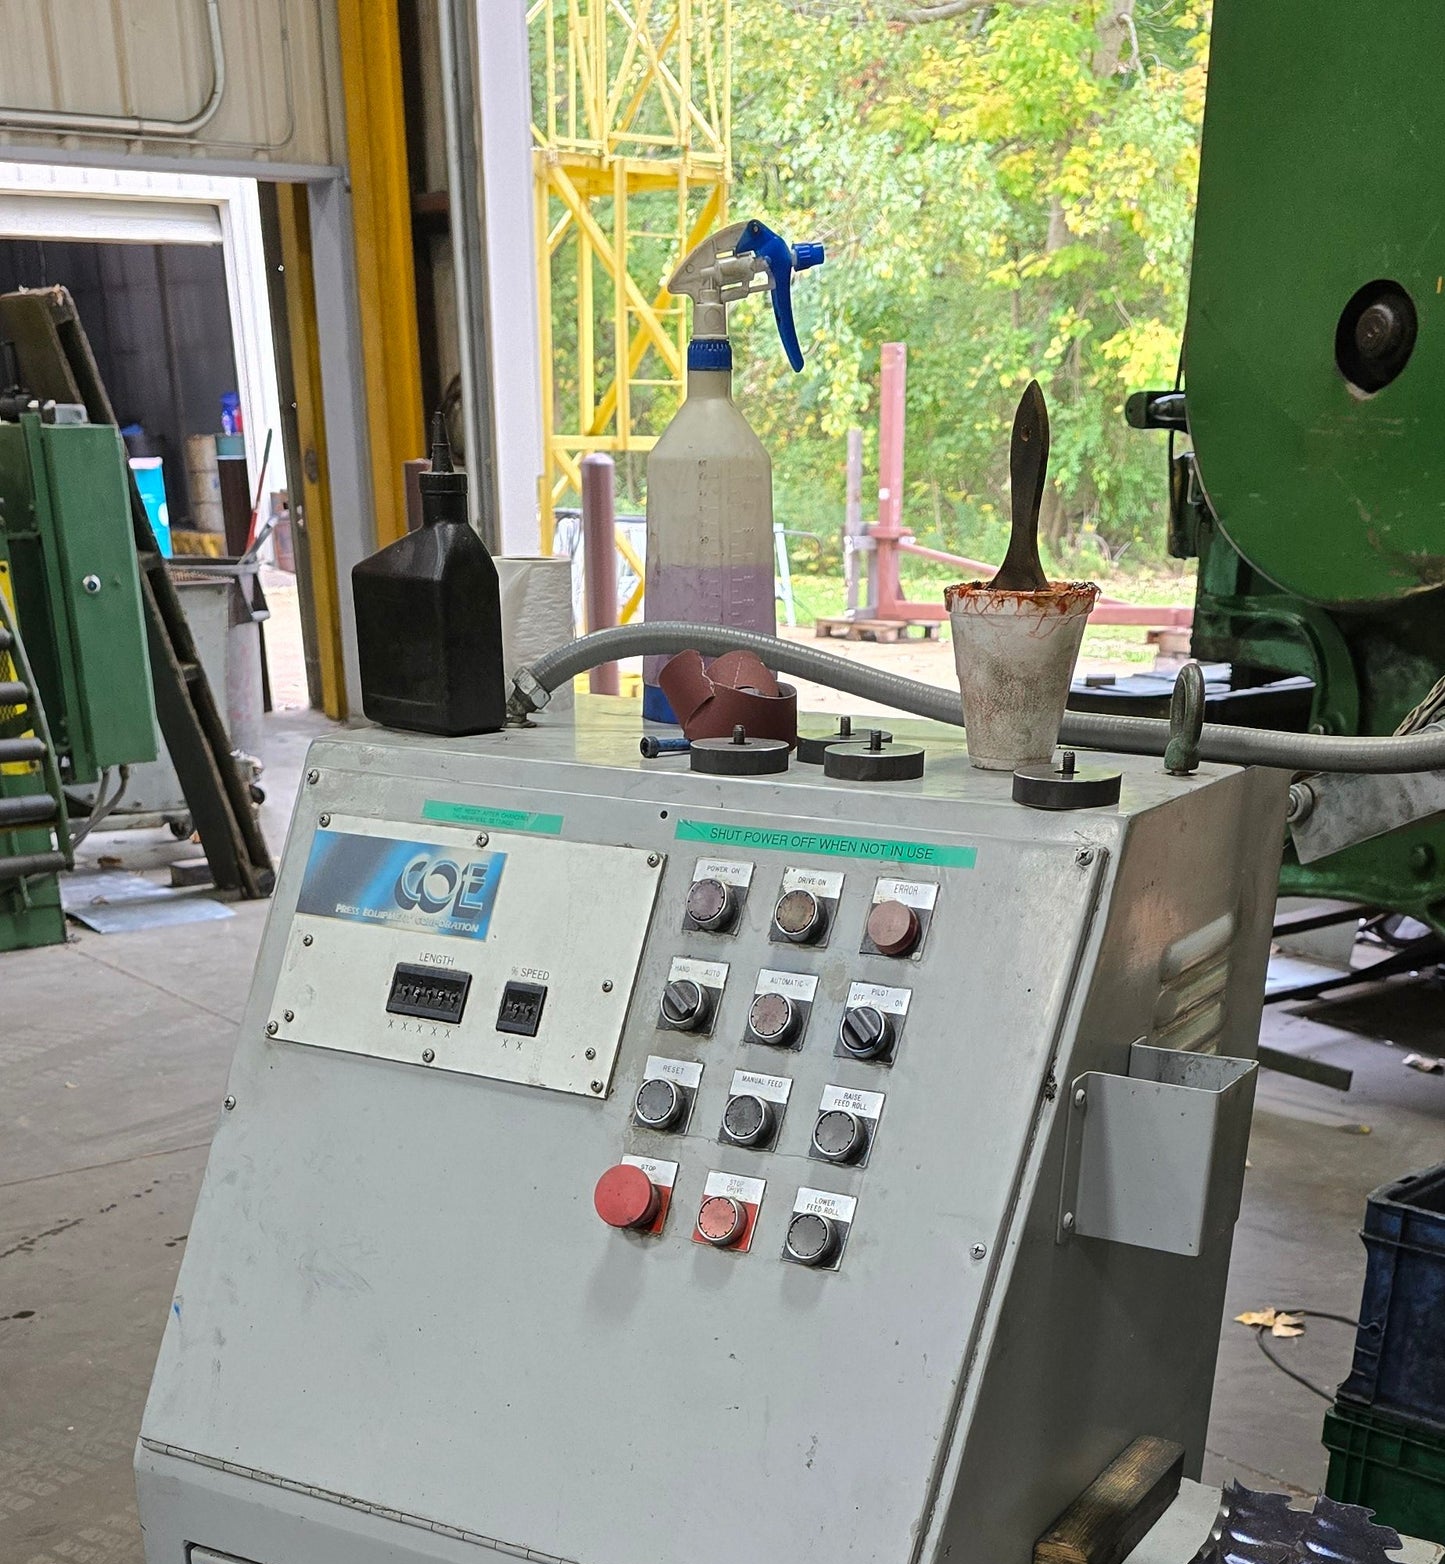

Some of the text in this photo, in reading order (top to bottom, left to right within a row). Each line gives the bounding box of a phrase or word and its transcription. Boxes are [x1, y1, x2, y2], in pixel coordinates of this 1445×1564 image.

[710, 827, 935, 860] SHUT POWER OFF WHEN NOT IN USE
[706, 864, 741, 876] POWER ON
[395, 853, 489, 918] COE
[797, 875, 828, 887] DRIVE ON
[893, 883, 920, 896] ERROR
[335, 903, 360, 916] PRESS
[418, 952, 455, 966] LENGTH
[510, 966, 550, 981] % SPEED
[674, 964, 721, 978] HAND AUTO
[769, 977, 806, 989] AUTOMATIC
[870, 987, 890, 998] PILOT
[853, 992, 905, 1008] OFF ON
[387, 1018, 395, 1029] X
[416, 1024, 423, 1034] X
[430, 1027, 438, 1037] X
[444, 1029, 451, 1039] X
[501, 1038, 523, 1051] X X
[662, 1064, 685, 1075] RESET
[741, 1075, 784, 1089] MANUAL FEED
[843, 1091, 862, 1101] RAISE
[833, 1099, 868, 1111] FEED ROLL
[640, 1163, 657, 1172] STOP
[729, 1178, 745, 1187] STOP
[814, 1196, 837, 1207] LOWER
[806, 1203, 840, 1216] FEED ROLL
